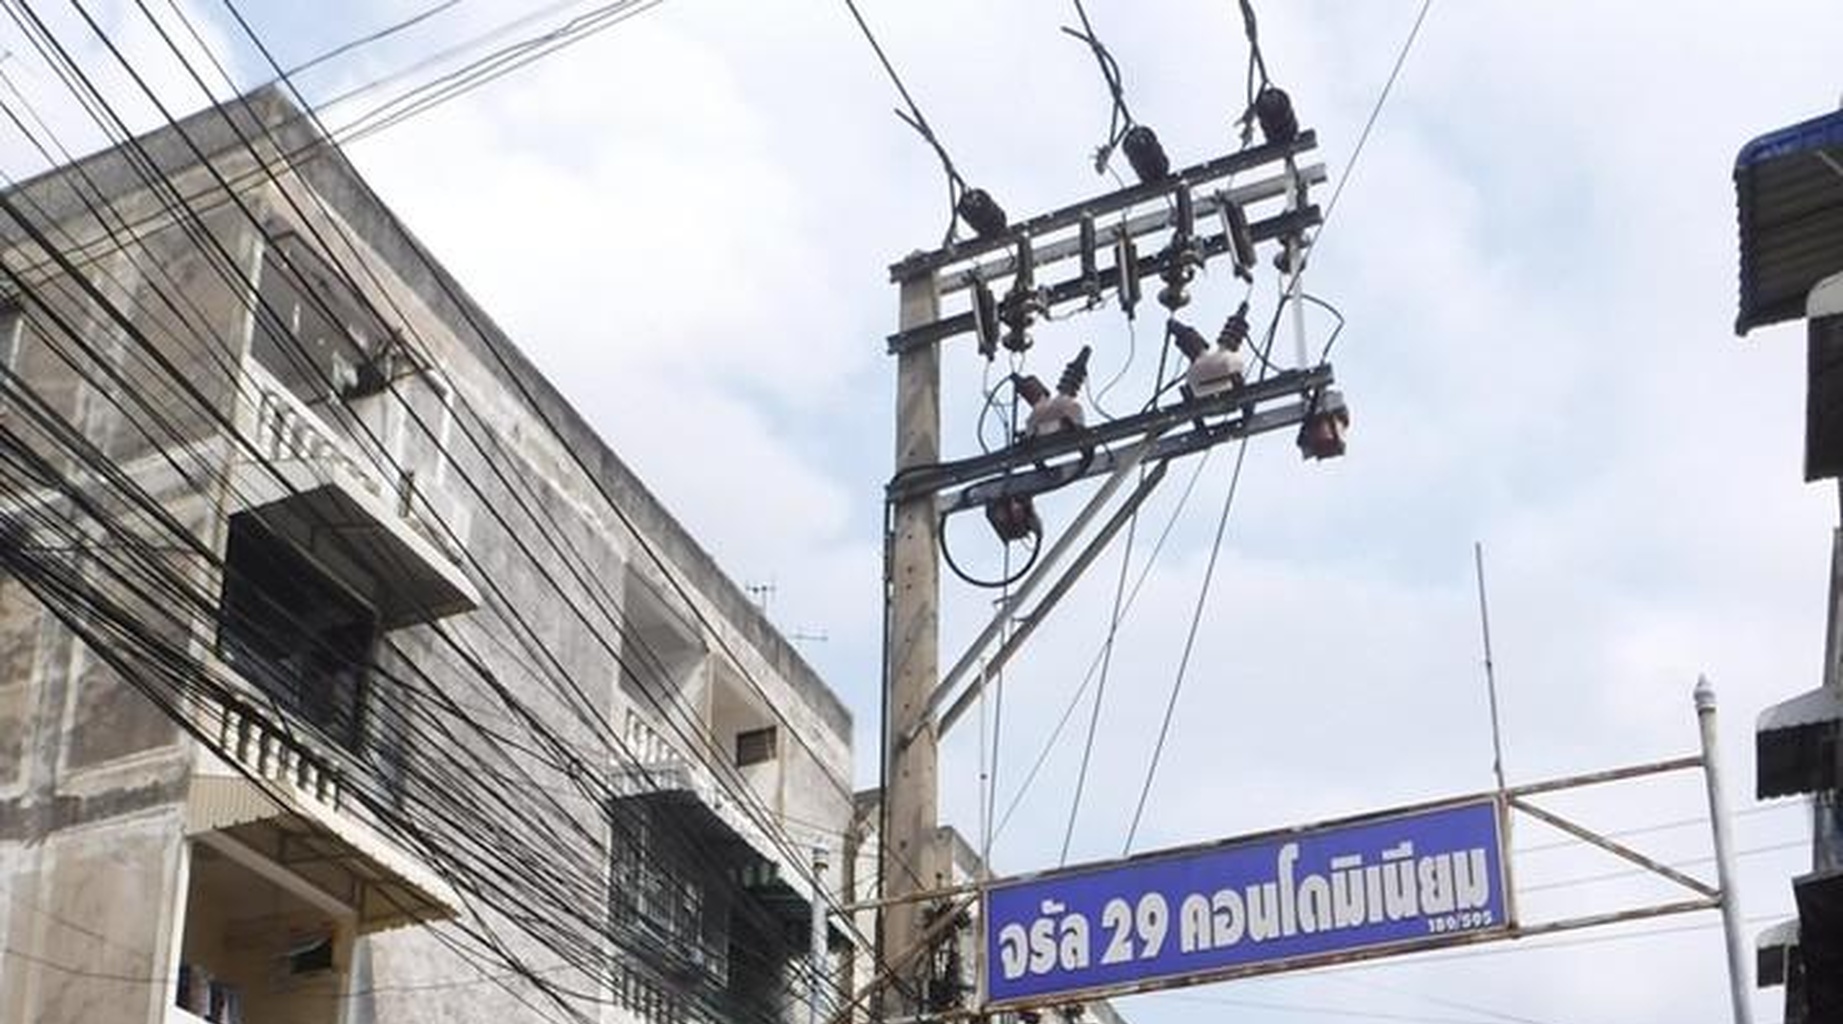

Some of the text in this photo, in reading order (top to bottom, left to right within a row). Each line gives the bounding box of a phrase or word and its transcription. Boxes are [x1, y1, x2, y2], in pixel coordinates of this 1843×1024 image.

[1000, 841, 1490, 980] จรัล 29 คอนโดมิเนียม
